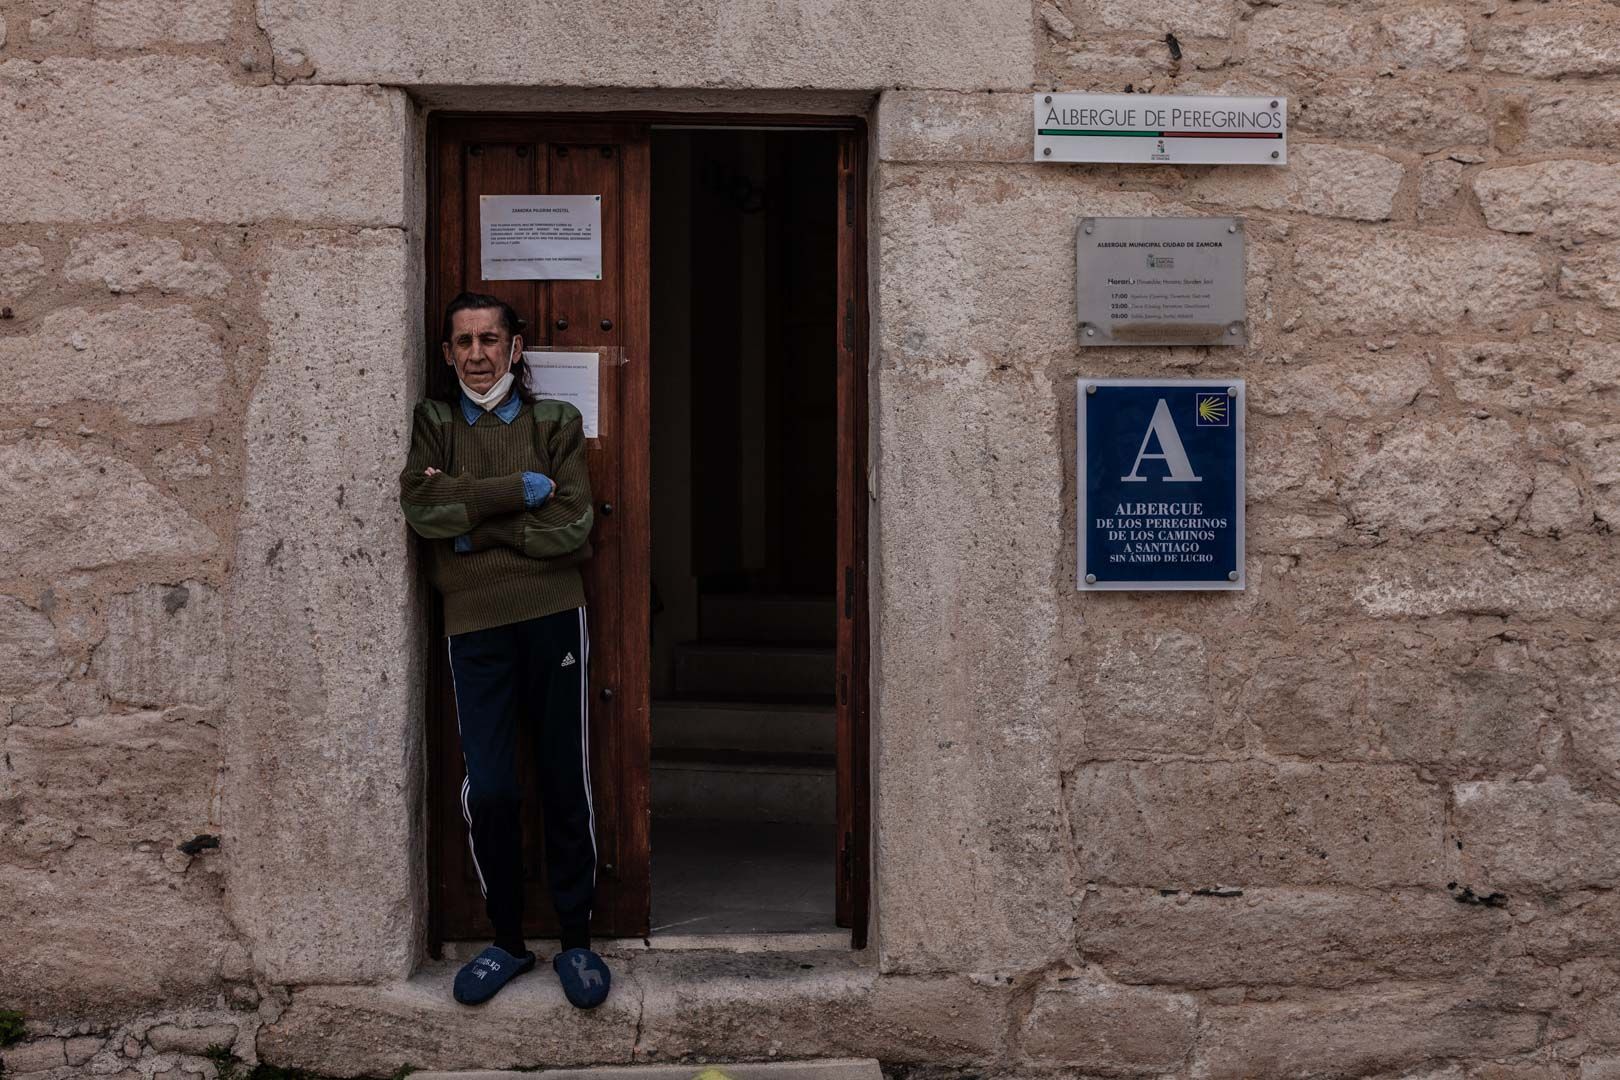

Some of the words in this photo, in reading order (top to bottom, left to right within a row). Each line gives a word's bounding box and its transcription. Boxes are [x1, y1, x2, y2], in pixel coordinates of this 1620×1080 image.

[1045, 107, 1136, 126] ALBERGUE
[1145, 110, 1166, 127] DE
[1172, 108, 1281, 129] PEREGRINOS
[1120, 398, 1203, 482] A
[1114, 503, 1203, 516] ALBERGUE
[1096, 519, 1114, 529] DE
[1118, 519, 1142, 529] LOS
[1146, 518, 1227, 529] PEREGRINOS
[1109, 530, 1126, 541] DE
[1130, 530, 1154, 541] LOS
[1158, 530, 1215, 541] CAMINOS
[1124, 542, 1135, 553] A
[1135, 542, 1199, 553] SANTIAGO
[1109, 554, 1126, 562] SIN
[1128, 552, 1161, 562] ÁNIMO
[1164, 554, 1178, 562] DE
[1180, 554, 1213, 562] LUCRO
